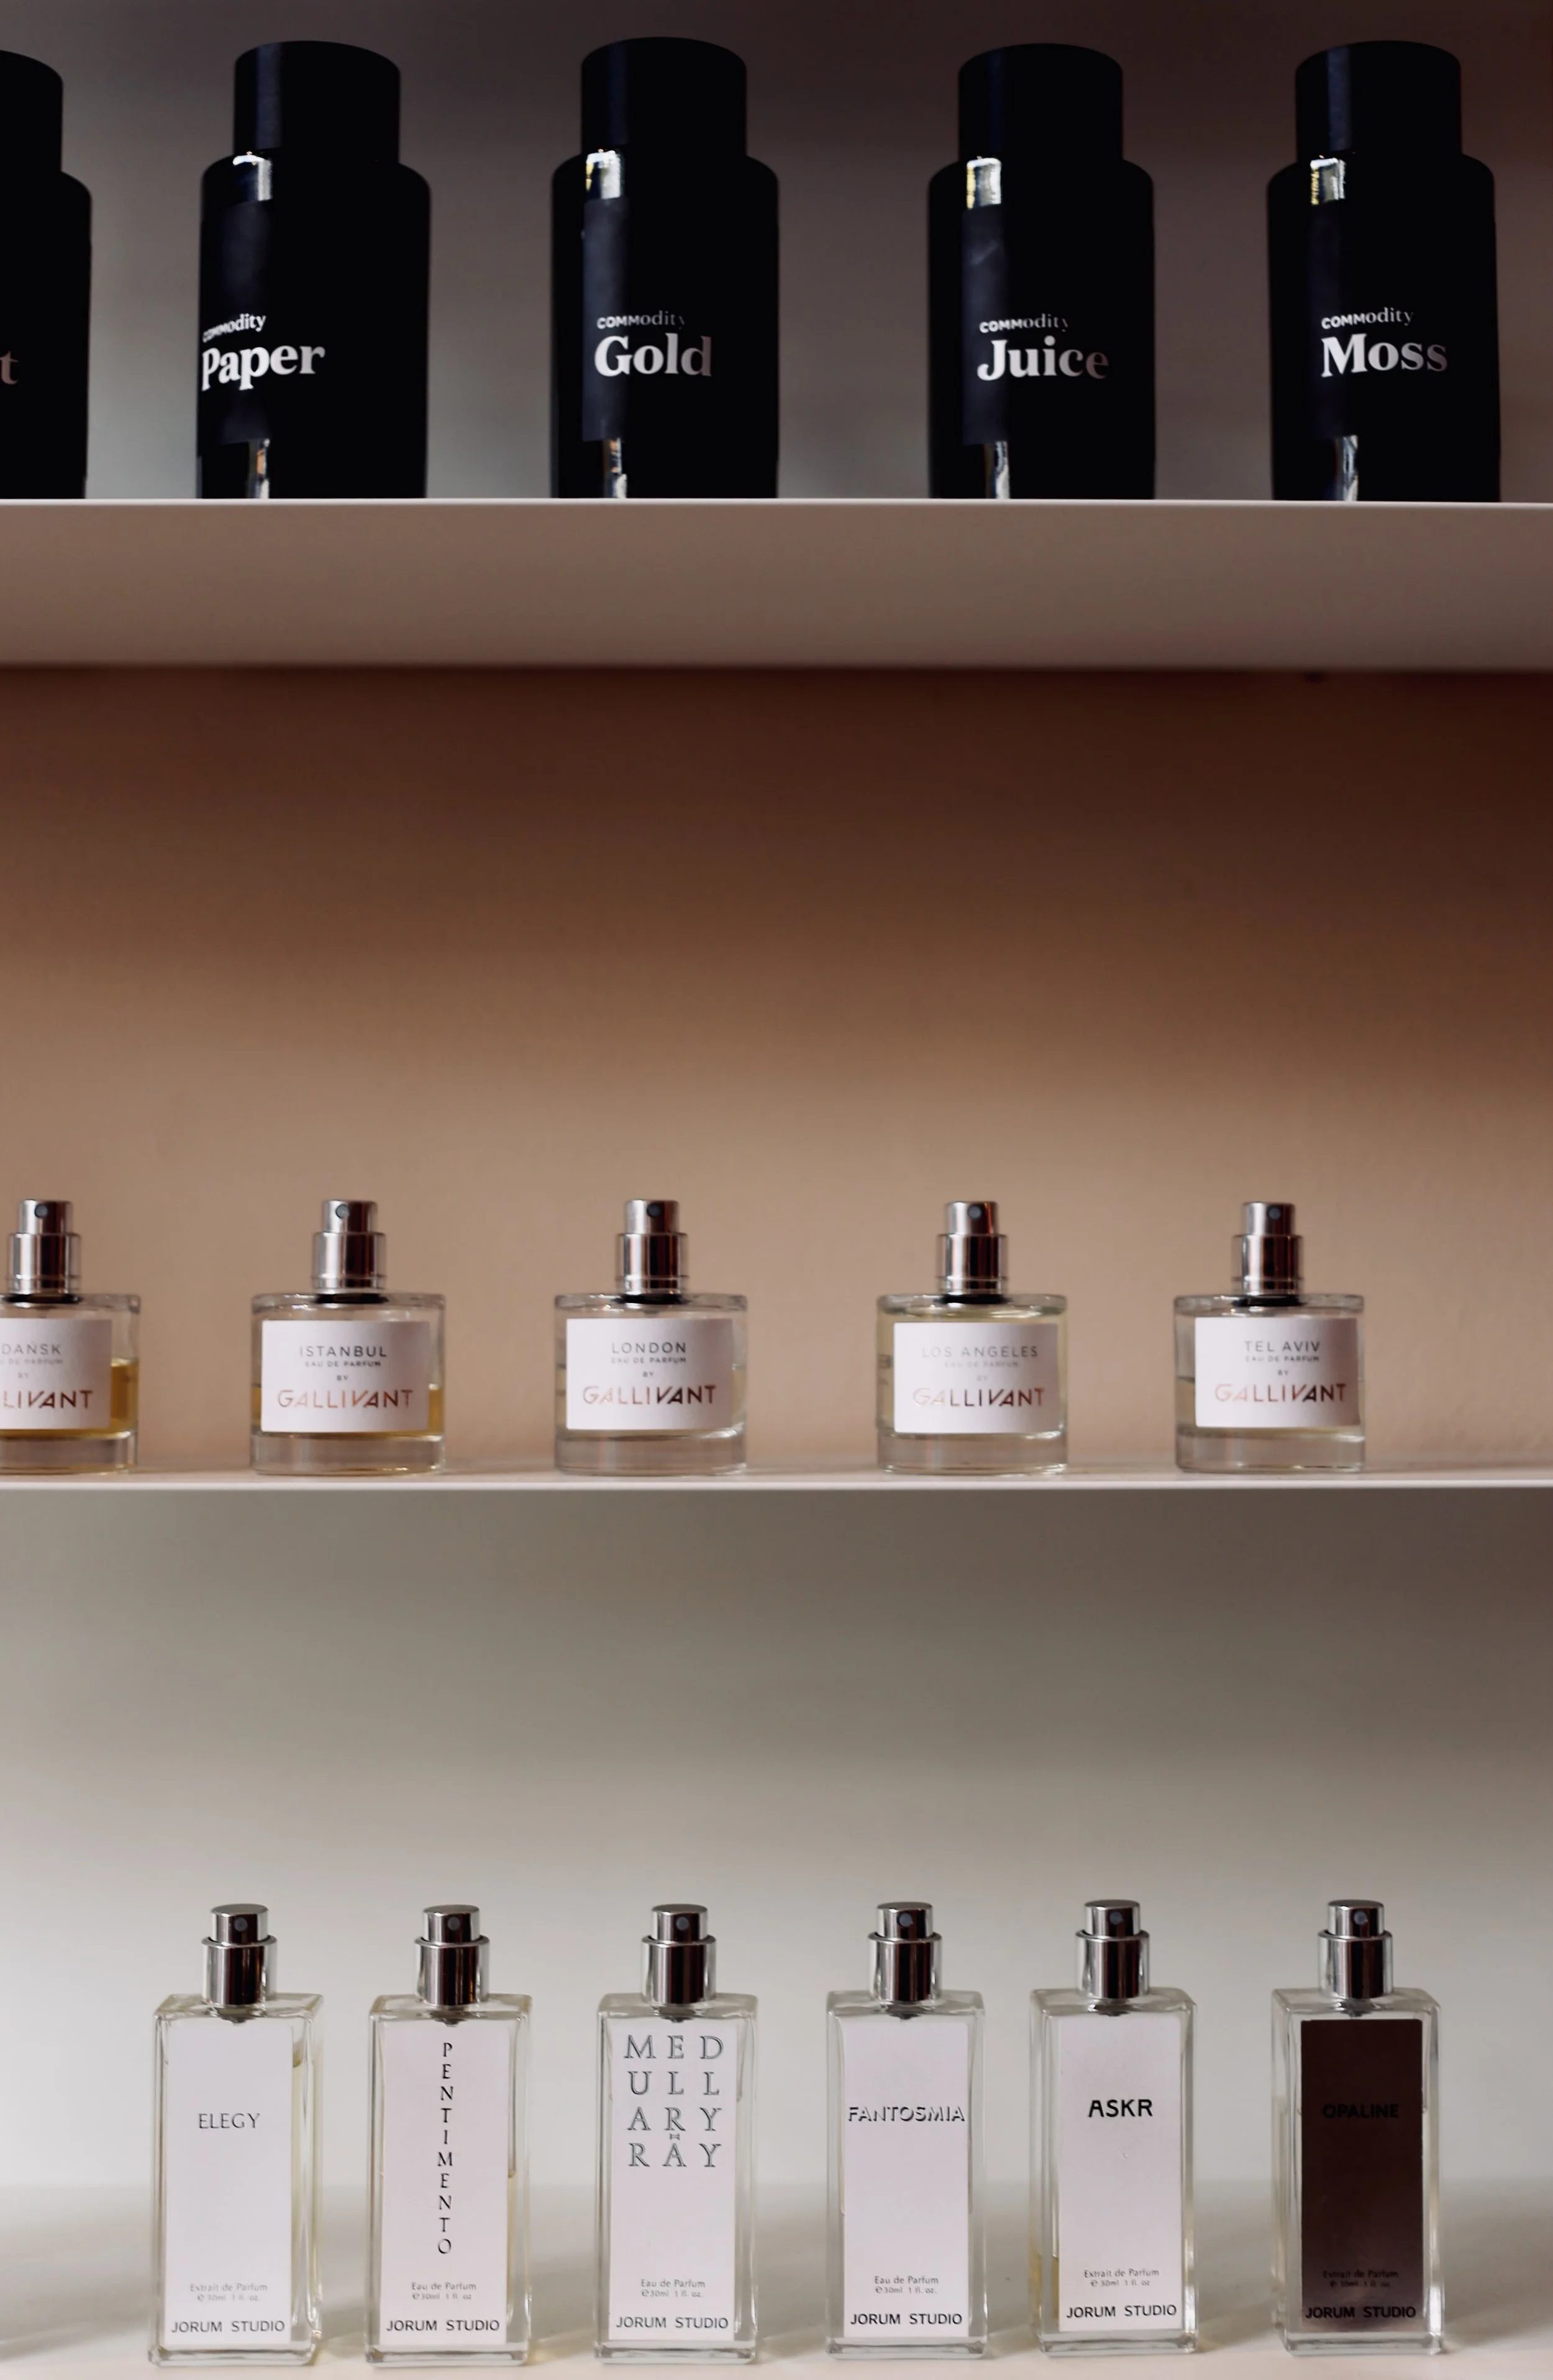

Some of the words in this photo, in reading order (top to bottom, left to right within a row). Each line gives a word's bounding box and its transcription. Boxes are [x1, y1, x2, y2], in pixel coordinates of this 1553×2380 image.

[594, 332, 712, 377] Gold
[977, 335, 1109, 381] Juice
[1321, 333, 1448, 378] Moss
[202, 345, 326, 391] Paper
[300, 1346, 387, 1357] ISTANBUL
[611, 1342, 686, 1353] LONDON
[922, 1347, 952, 1357] LOS
[961, 1346, 1039, 1357] ANGELES
[1245, 1341, 1275, 1351] TEL
[1282, 1341, 1320, 1351] AVIV
[278, 1389, 413, 1408] GALLIVANT
[583, 1385, 717, 1404] GALLIVANT
[913, 1388, 1045, 1407] GALLIVANT
[1215, 1383, 1346, 1402] GALLIVANT
[849, 2106, 965, 2122] FANTOSMIA
[1088, 2099, 1153, 2117] ASKR
[1322, 2103, 1400, 2119] OPALINE
[199, 2113, 260, 2128] ELEGY
[437, 2042, 453, 2254] PENTIMENTO
[1083, 2269, 1111, 2278] Extrait
[1114, 2268, 1126, 2277] de
[1129, 2268, 1160, 2276] Parfum
[1323, 2269, 1351, 2279] Extrait
[1354, 2269, 1365, 2278] de
[1368, 2269, 1398, 2278] Parfum
[411, 2282, 427, 2290] Eau
[431, 2282, 442, 2290] de
[445, 2282, 476, 2291] Parfum
[641, 2279, 657, 2287] Eau
[660, 2279, 671, 2287] de
[674, 2279, 705, 2288] Parfum
[875, 2276, 890, 2284] Eau
[894, 2276, 904, 2284] de
[908, 2276, 939, 2284] Parfum
[190, 2284, 219, 2292] Extrait
[222, 2284, 233, 2292] de
[237, 2283, 268, 2292] Parfum
[1066, 2306, 1116, 2318] JORUM
[1124, 2305, 1177, 2317] STUDIO
[1306, 2306, 1355, 2319] JORUM
[1363, 2305, 1416, 2317] STUDIO
[386, 2320, 437, 2331] JORUM
[446, 2320, 499, 2331] STUDIO
[616, 2317, 667, 2328] JORUM
[675, 2317, 728, 2328] STUDIO
[850, 2314, 901, 2325] JORUM
[909, 2314, 962, 2324] STUDIO
[171, 2322, 222, 2333] JORUM
[231, 2320, 285, 2332] STUDIO
